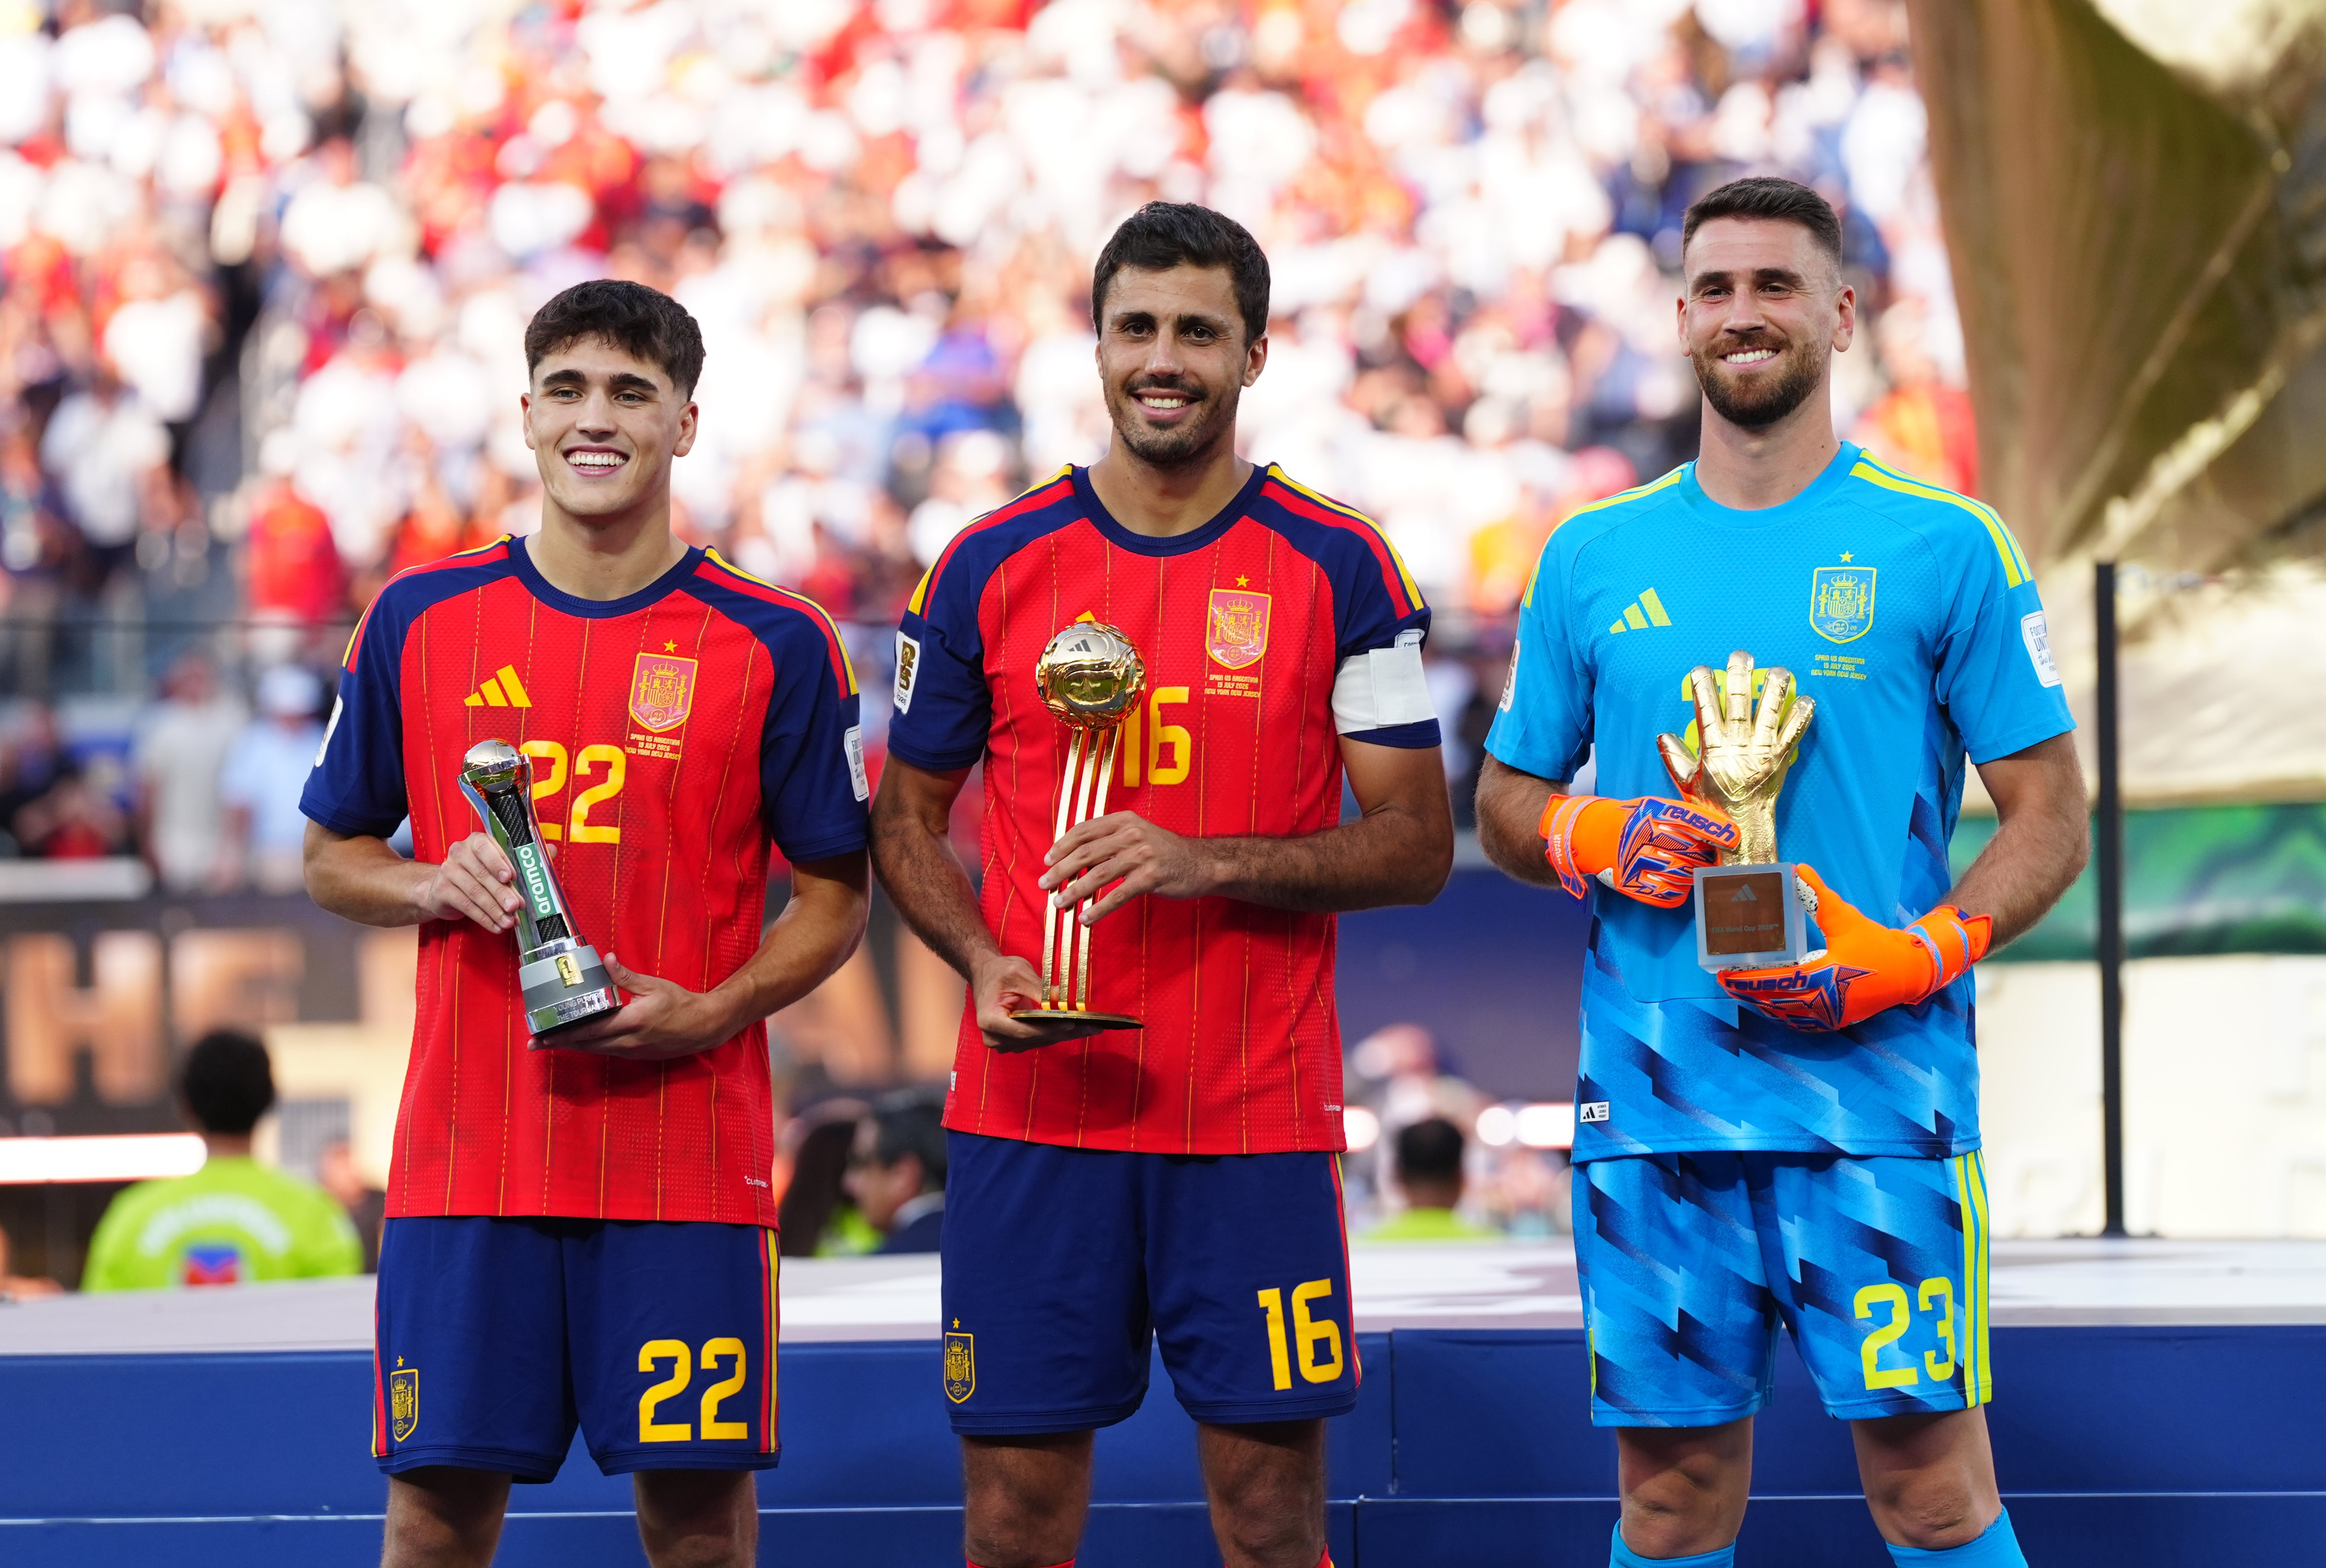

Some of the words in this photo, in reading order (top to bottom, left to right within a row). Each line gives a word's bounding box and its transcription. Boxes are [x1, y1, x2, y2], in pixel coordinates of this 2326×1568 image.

[1838, 656, 1865, 665] ARGENTINA
[1232, 675, 1259, 683] ARGENTINA
[1849, 672, 1867, 680] JERSEY
[653, 737, 680, 746] ARGENTINA
[663, 752, 682, 760] JERSEY
[518, 740, 627, 845] 22
[1662, 804, 1735, 842] reusch
[520, 846, 551, 914] aramco
[1725, 969, 1808, 992] reusch
[553, 1000, 577, 1013] YOUNG
[556, 1012, 570, 1022] THE
[1257, 1278, 1343, 1390] 16
[1853, 1276, 1956, 1390] 23
[638, 1337, 748, 1443] 22
